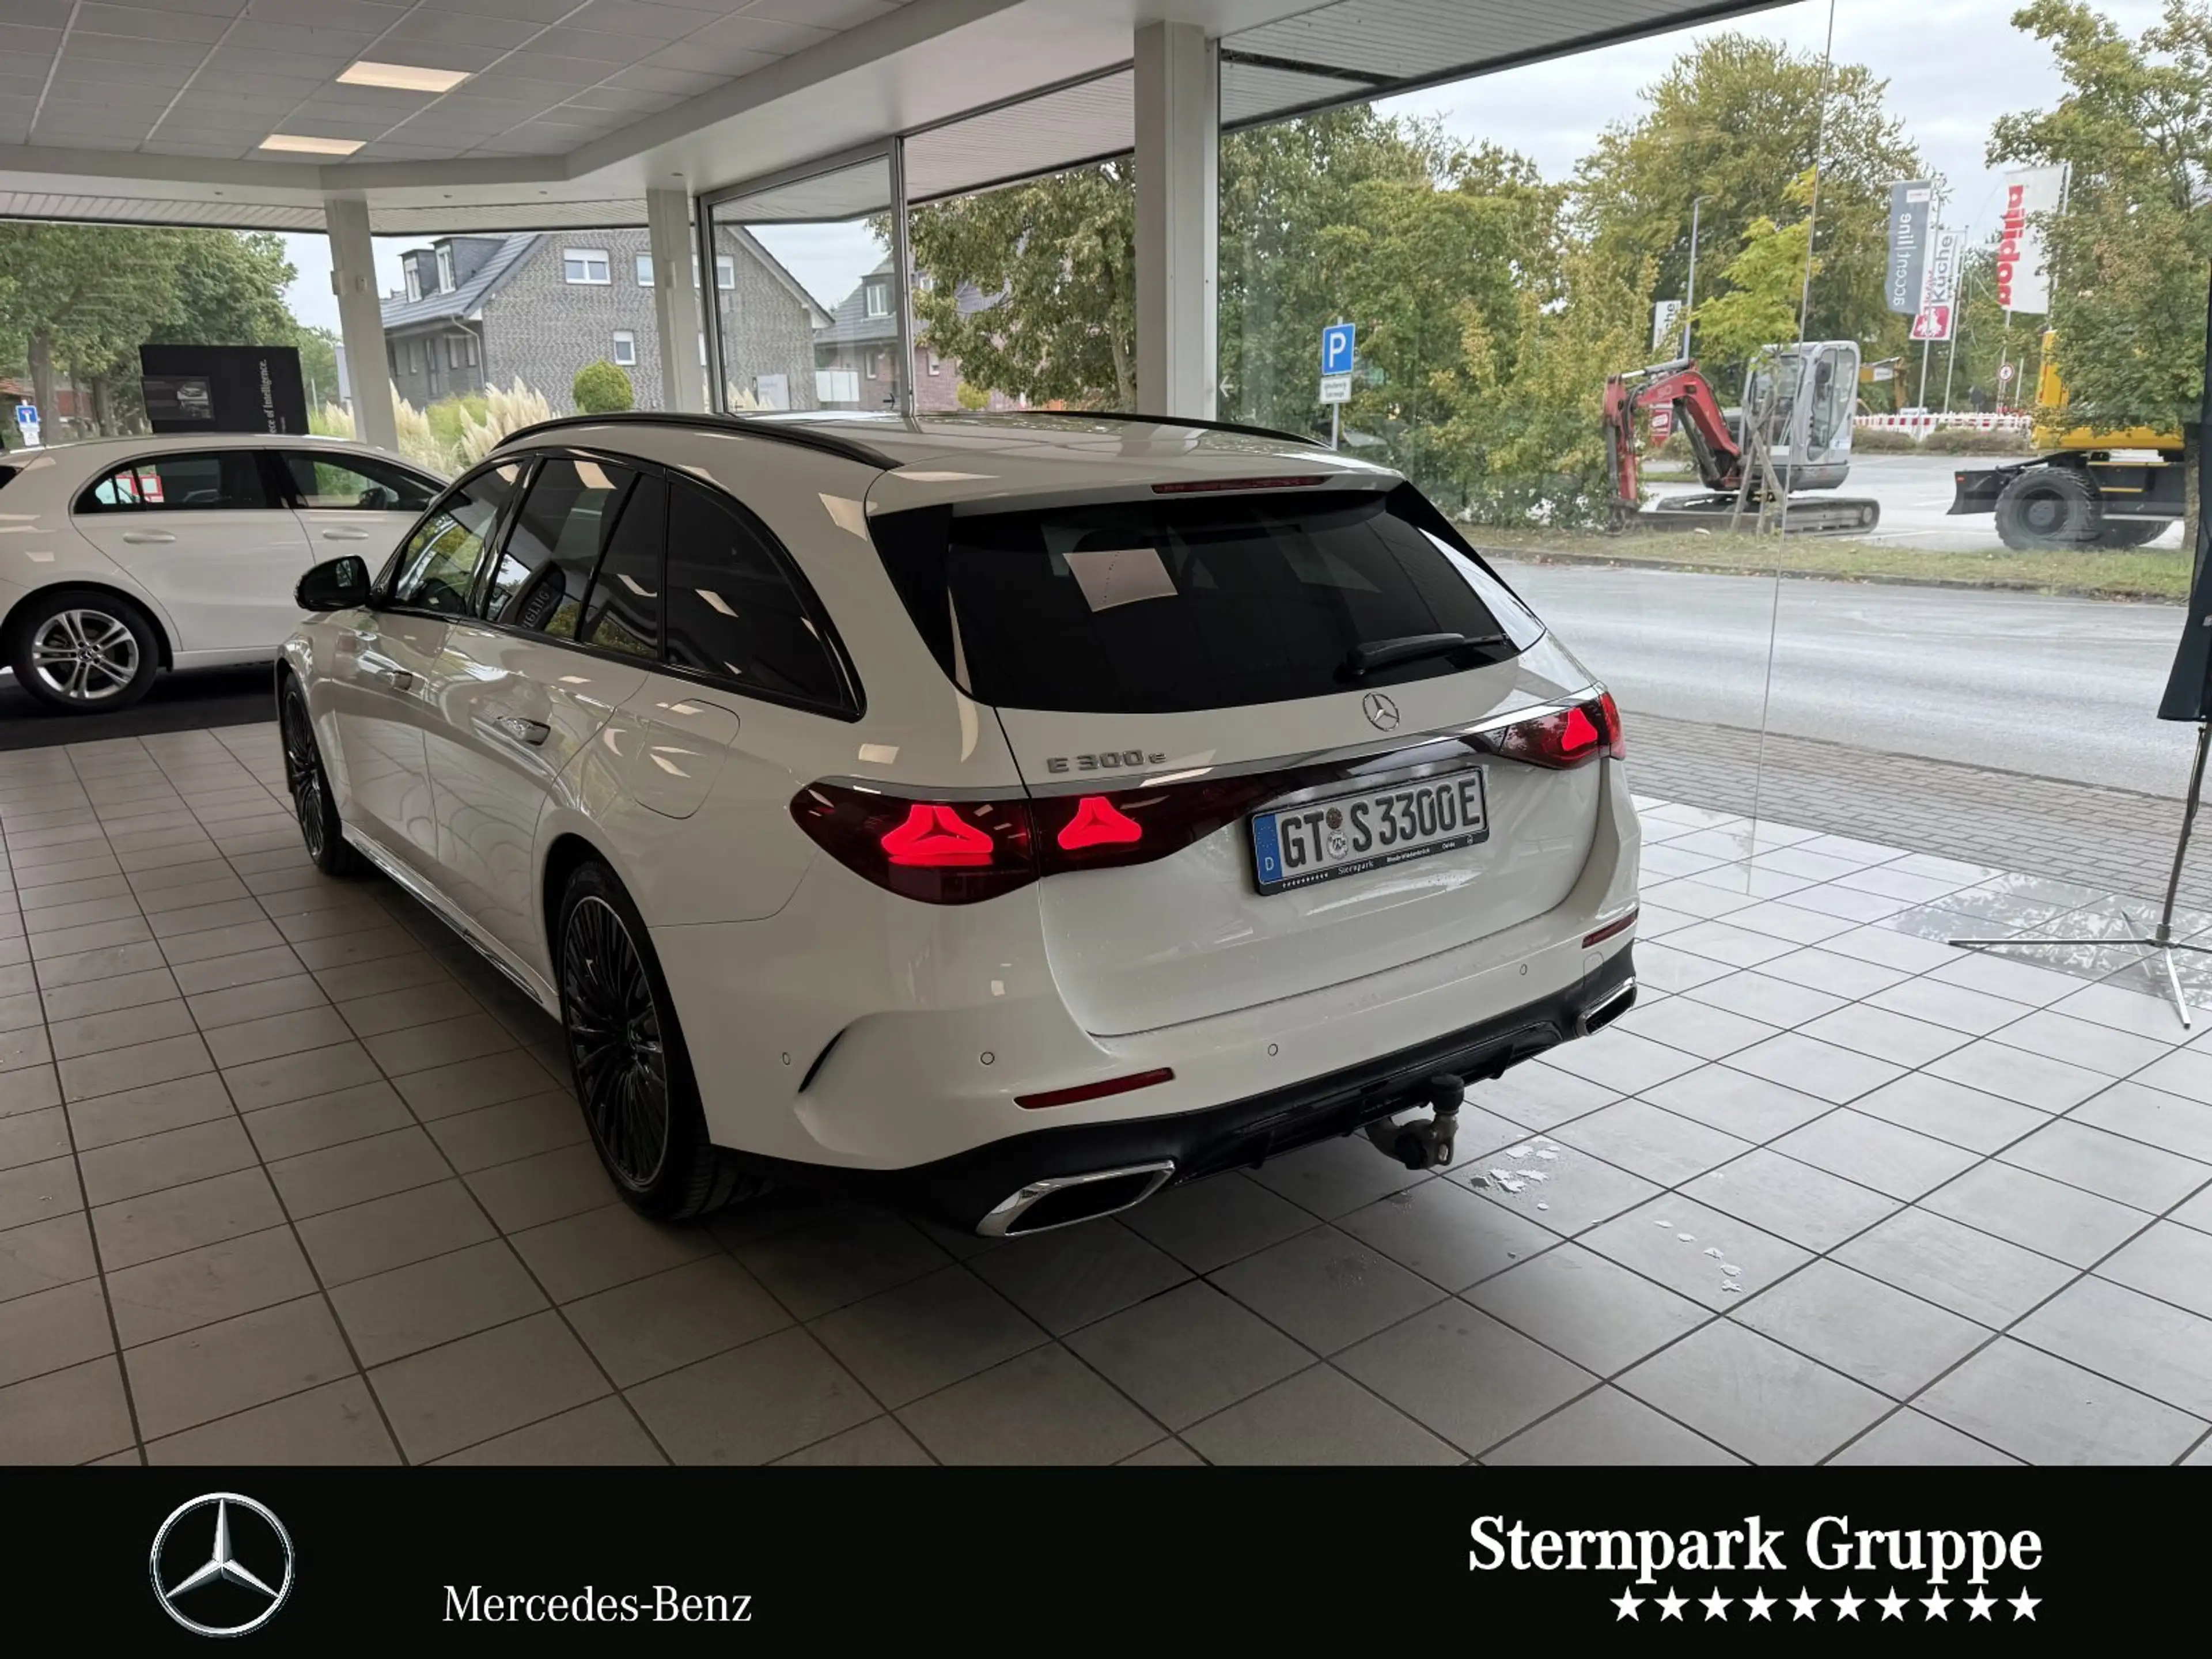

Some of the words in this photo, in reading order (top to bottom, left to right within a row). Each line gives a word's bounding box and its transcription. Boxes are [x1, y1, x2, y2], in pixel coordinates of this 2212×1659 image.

[1329, 332, 1346, 368] P
[1046, 757, 1069, 773] E
[1281, 809, 1327, 868] GT
